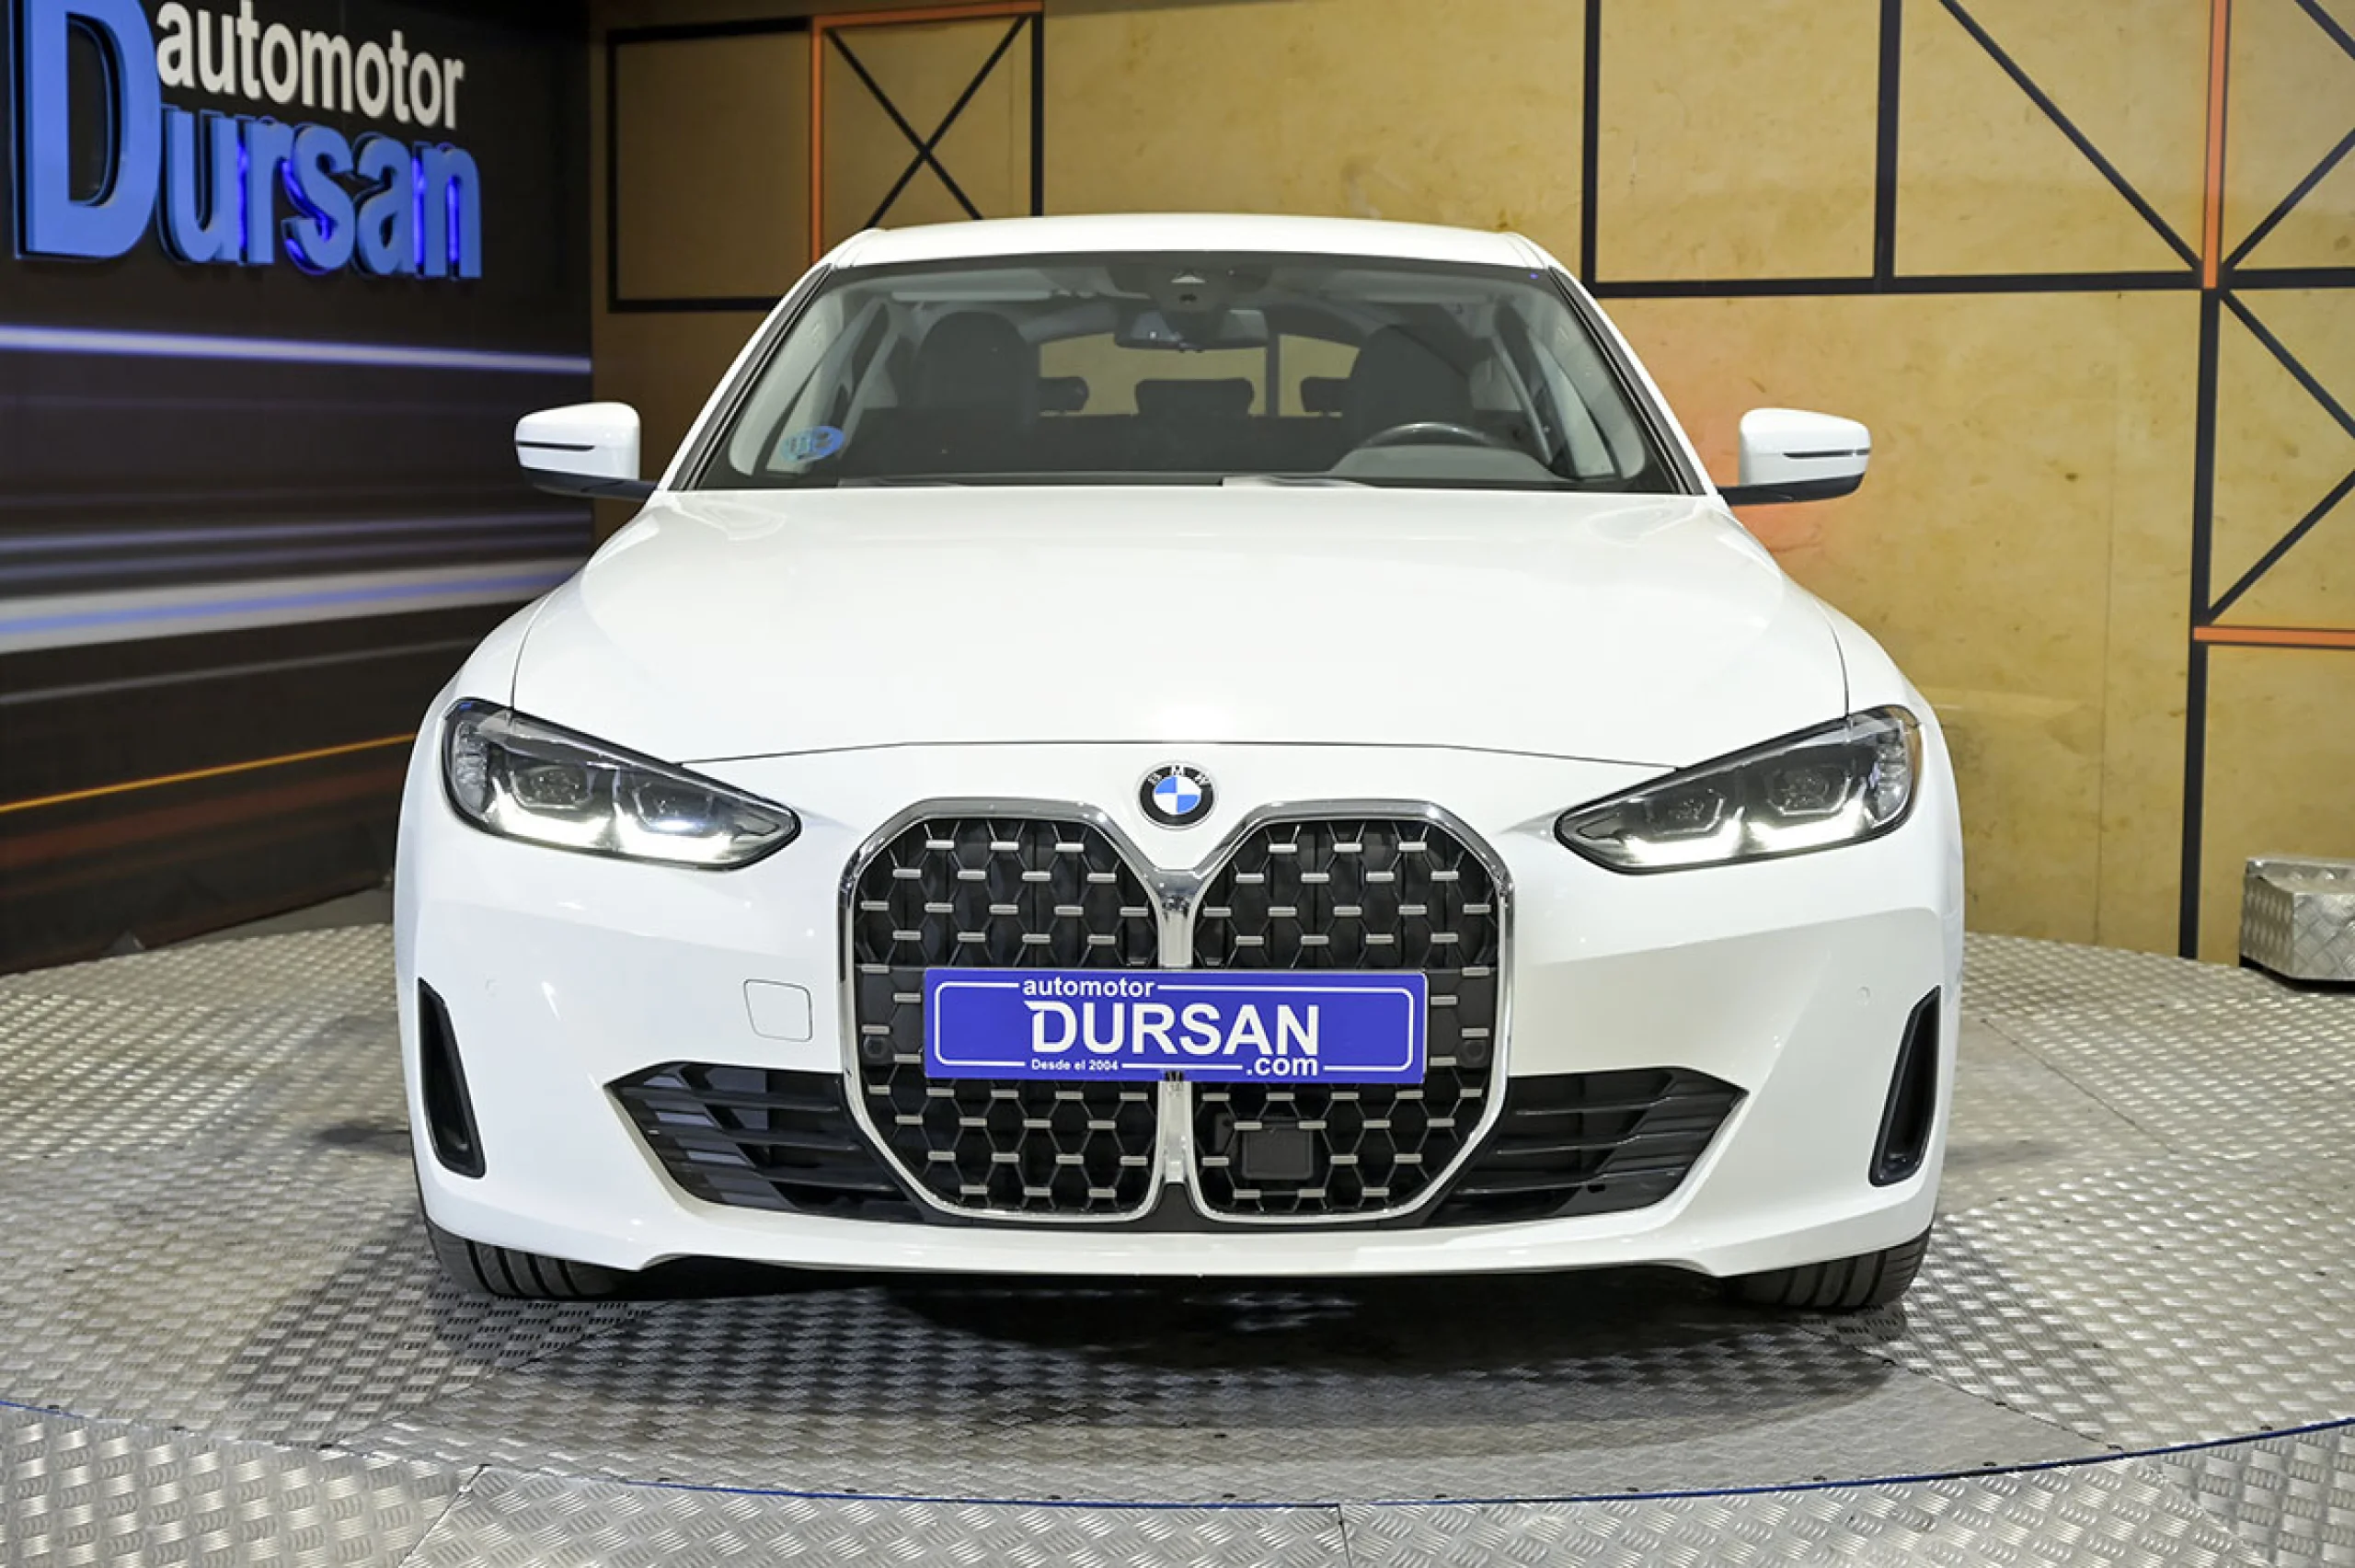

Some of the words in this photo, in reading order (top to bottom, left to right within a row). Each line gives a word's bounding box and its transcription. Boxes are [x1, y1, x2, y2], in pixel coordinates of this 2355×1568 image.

[156, 1, 464, 129] automotor
[11, 0, 482, 280] Dursan
[1022, 976, 1156, 997] automotor
[1024, 1000, 1319, 1056] DURSAN
[1031, 1059, 1071, 1070] Desde
[1074, 1059, 1086, 1070] el
[1088, 1059, 1120, 1071] 2004
[1246, 1057, 1319, 1077] .com
